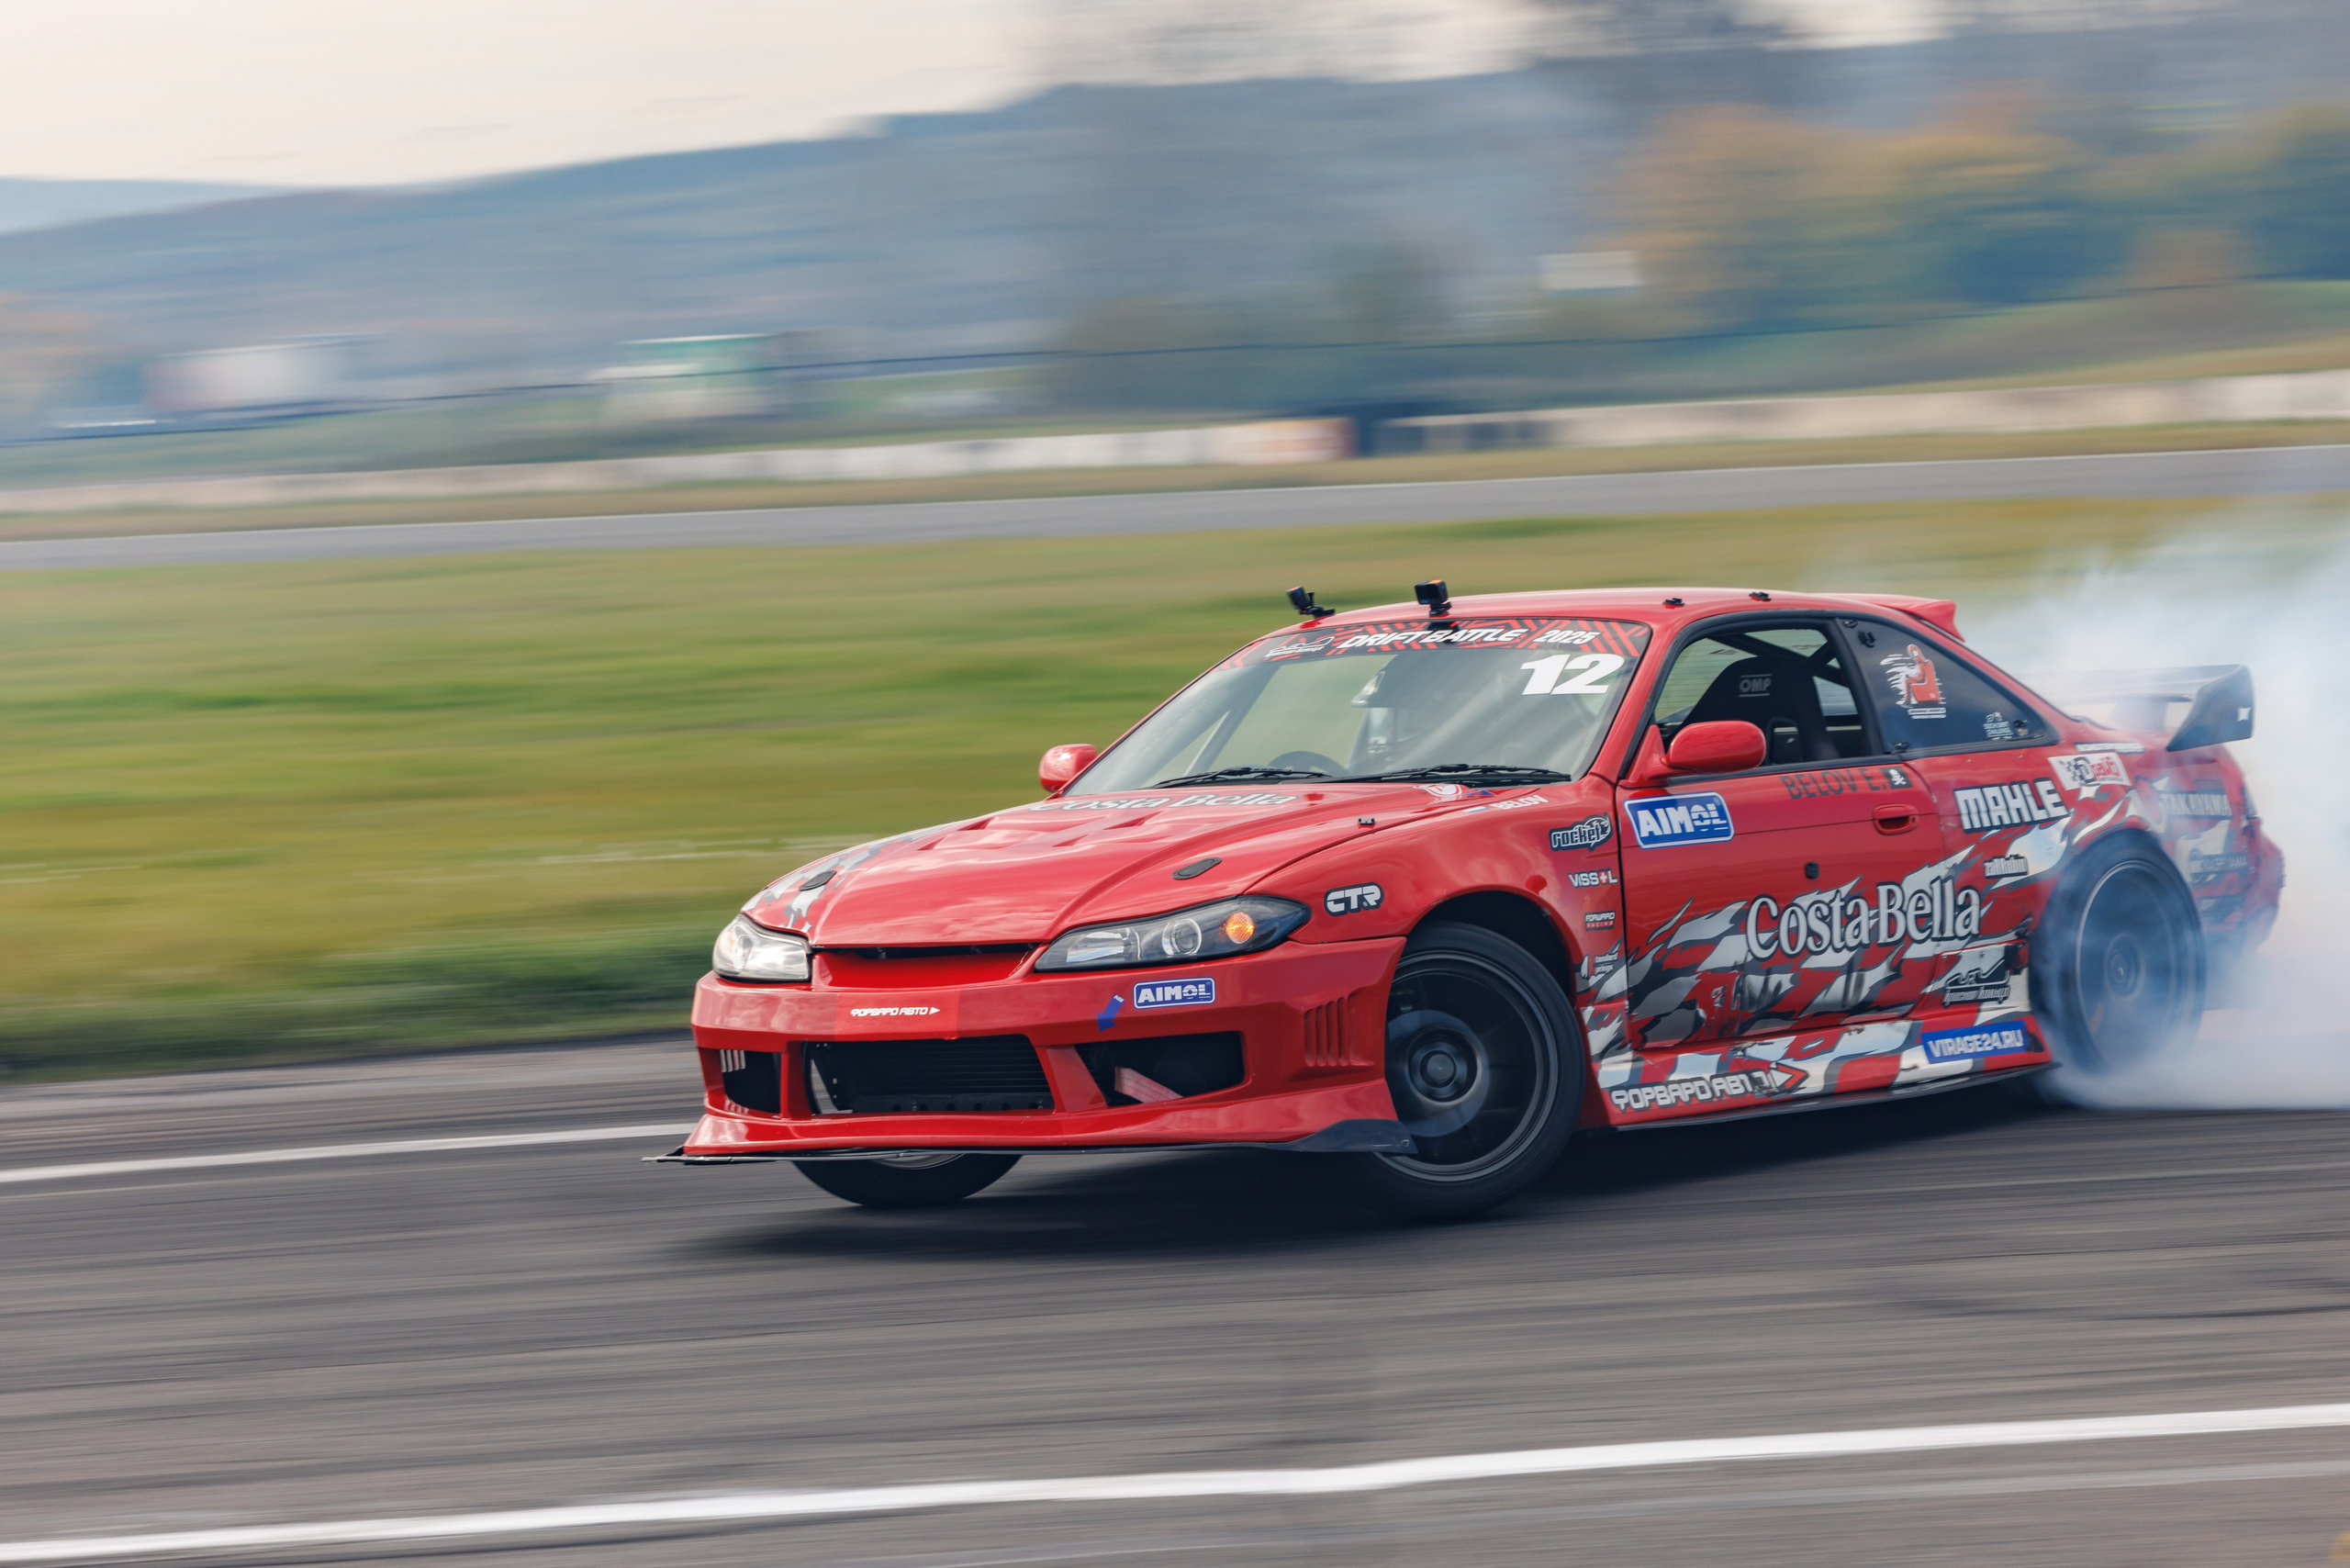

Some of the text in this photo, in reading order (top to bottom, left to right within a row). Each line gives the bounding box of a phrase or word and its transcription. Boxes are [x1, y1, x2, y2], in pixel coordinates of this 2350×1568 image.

[1337, 628, 1601, 649] DRIFT BATTLE 2025
[1519, 653, 1625, 696] 12
[1740, 678, 1772, 693] OMP
[1780, 767, 1887, 800] BELOV E.
[1170, 793, 1299, 808] Bella
[1489, 794, 1550, 810] BELOV
[1953, 779, 2069, 830] MAHLE
[1637, 803, 1728, 837] AIMOL
[1326, 885, 1382, 913] CTR
[1746, 876, 1980, 958] Costa Bella
[1137, 983, 1212, 1003] AIMOL
[1927, 1028, 2024, 1058] VIRAGE24.RU
